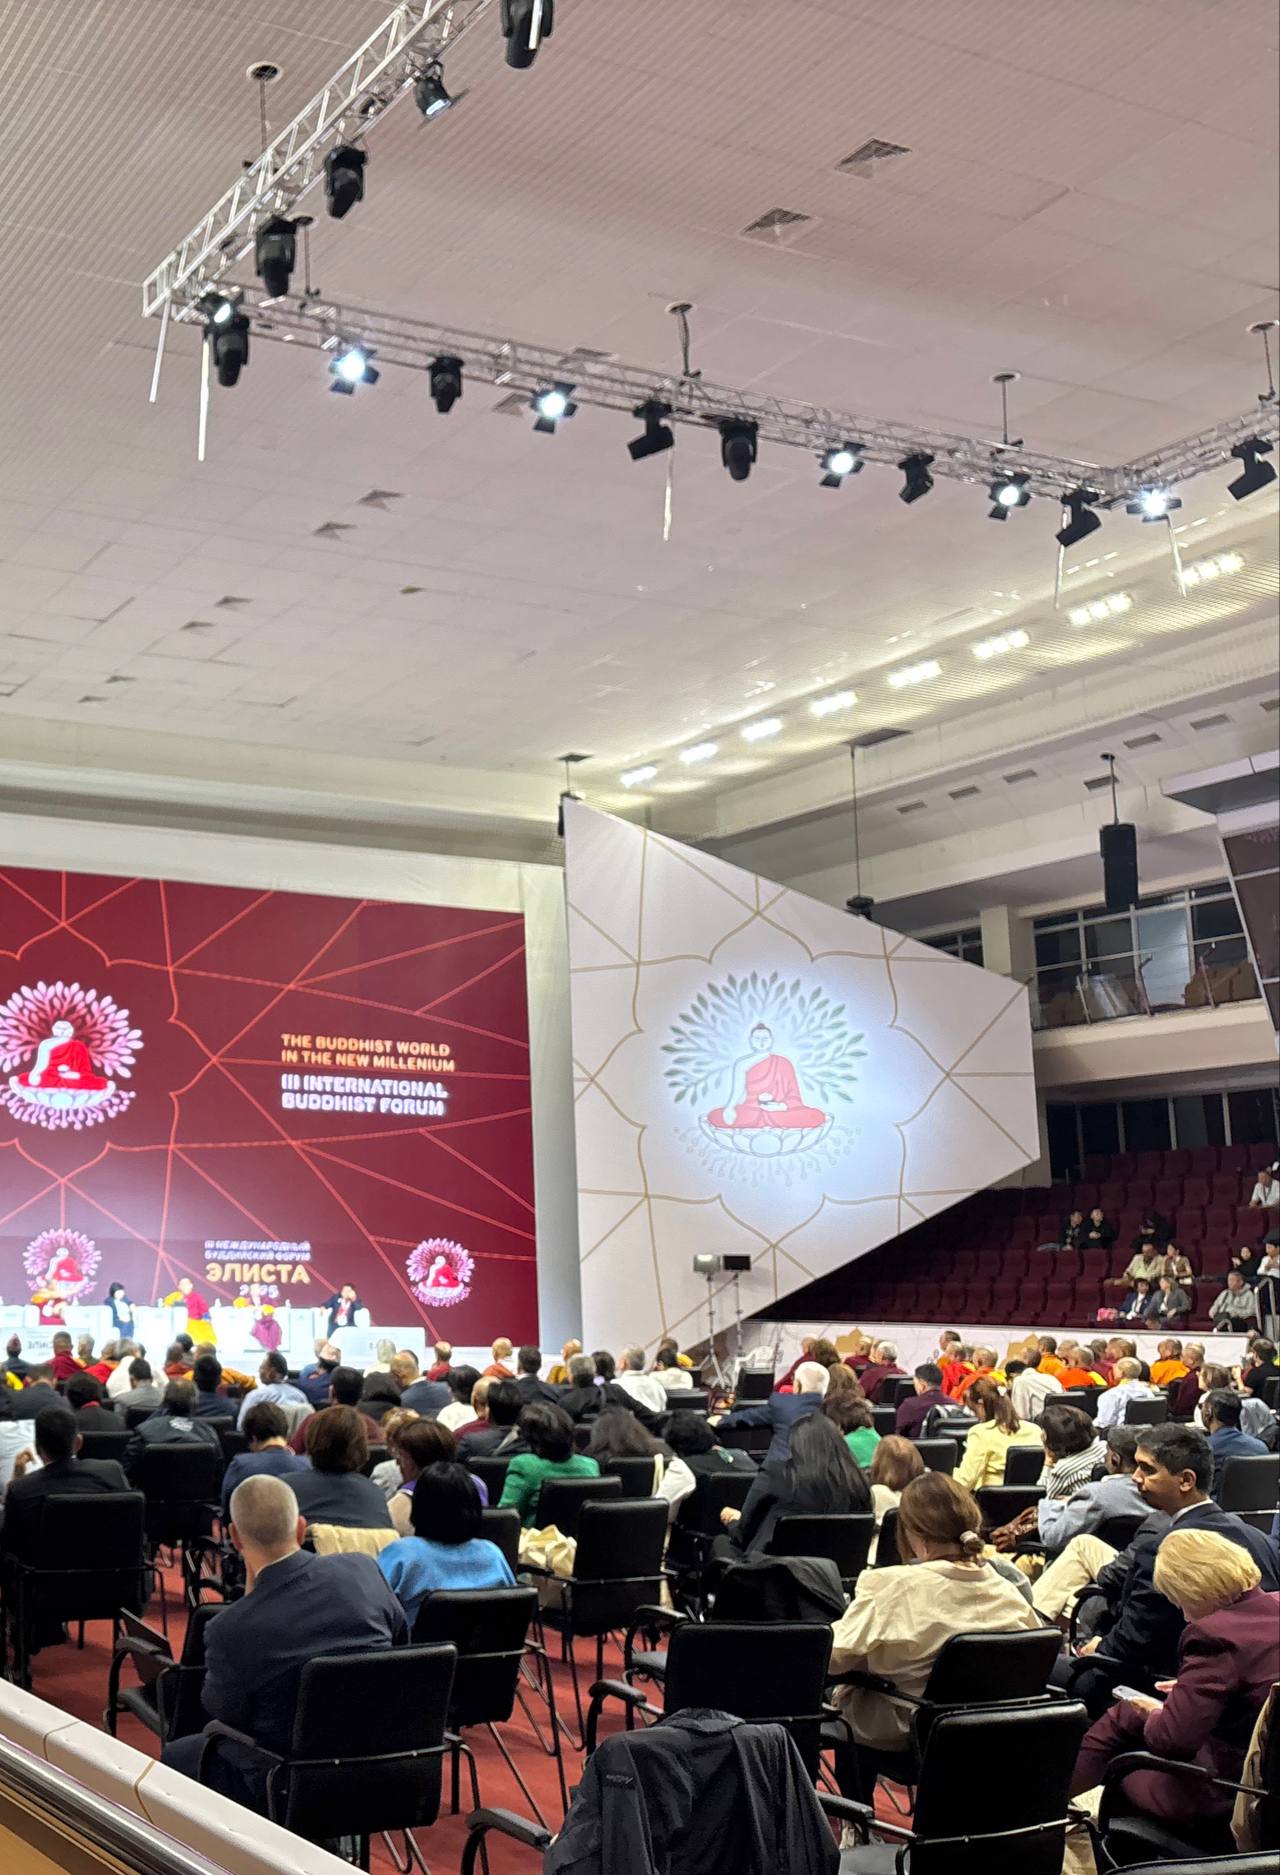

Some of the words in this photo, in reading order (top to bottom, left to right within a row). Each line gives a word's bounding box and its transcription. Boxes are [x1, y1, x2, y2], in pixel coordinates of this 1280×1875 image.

[281, 1033, 312, 1048] THE
[316, 1035, 393, 1053] BUDDHIST
[396, 1042, 450, 1057] WORLD
[281, 1049, 298, 1063] IN
[301, 1051, 332, 1065] THE
[335, 1053, 370, 1067] NEW
[373, 1055, 455, 1073] MILLENIUM
[281, 1073, 300, 1090] III
[303, 1075, 449, 1098] INTERNATIONAL
[281, 1092, 377, 1112] BUDDHIST
[380, 1097, 445, 1116] FORUM
[206, 1262, 311, 1284] ЭЛИСТА
